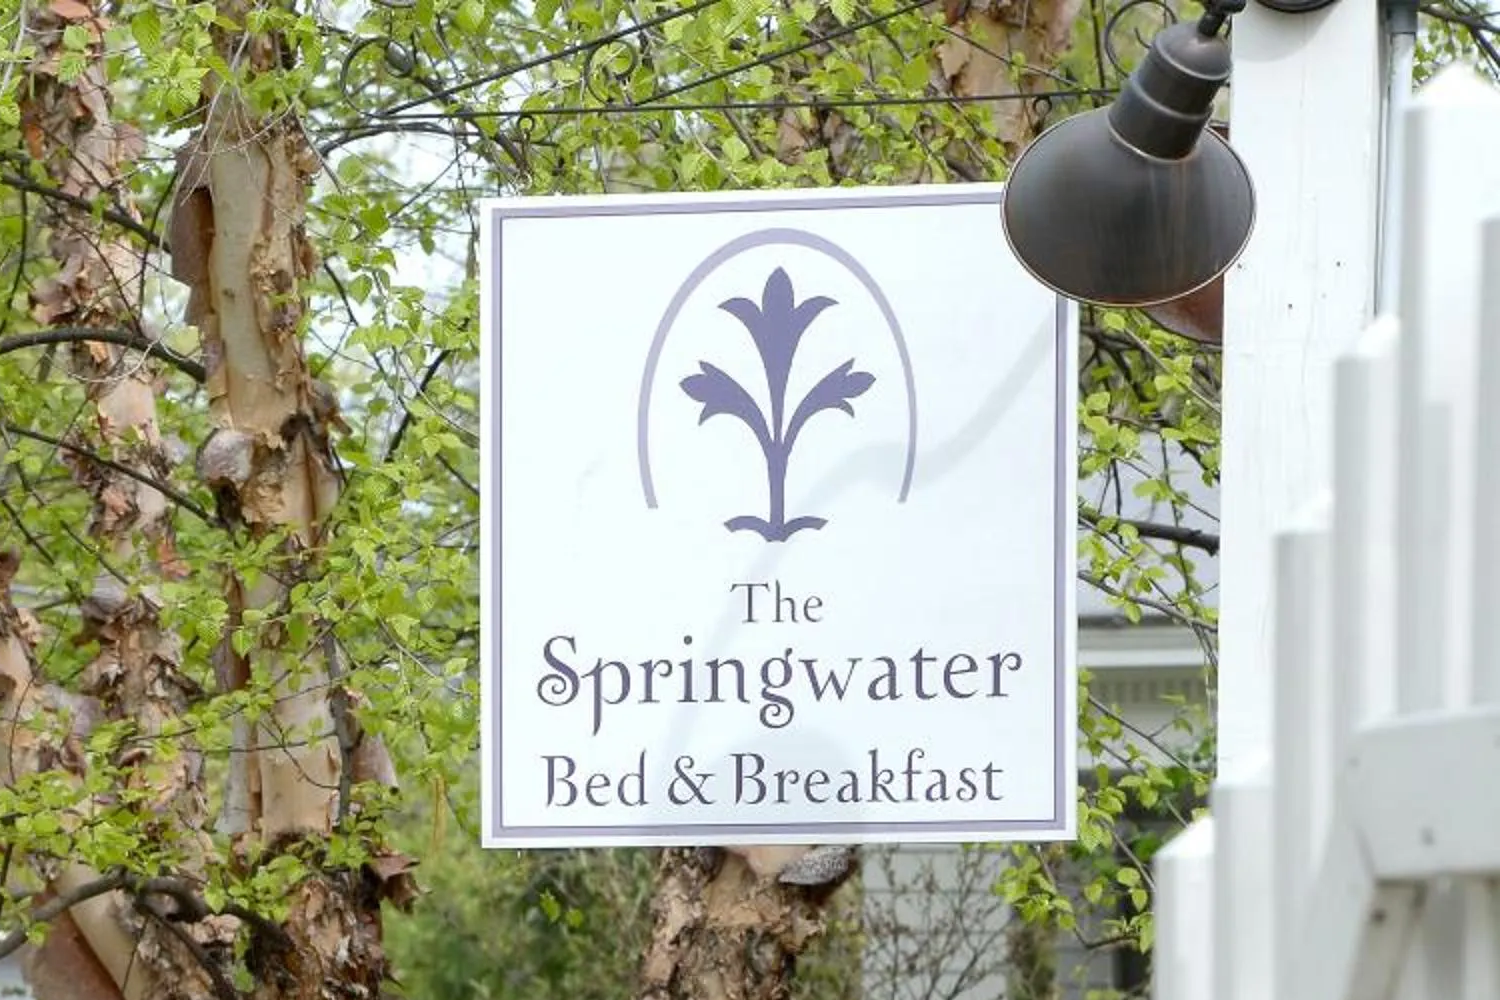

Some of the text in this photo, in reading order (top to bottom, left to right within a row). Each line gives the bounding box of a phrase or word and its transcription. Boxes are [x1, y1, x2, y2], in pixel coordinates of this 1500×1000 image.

[730, 580, 824, 624] The
[537, 635, 1023, 736] Springwater
[540, 747, 1004, 808] Bed & Breakfast
